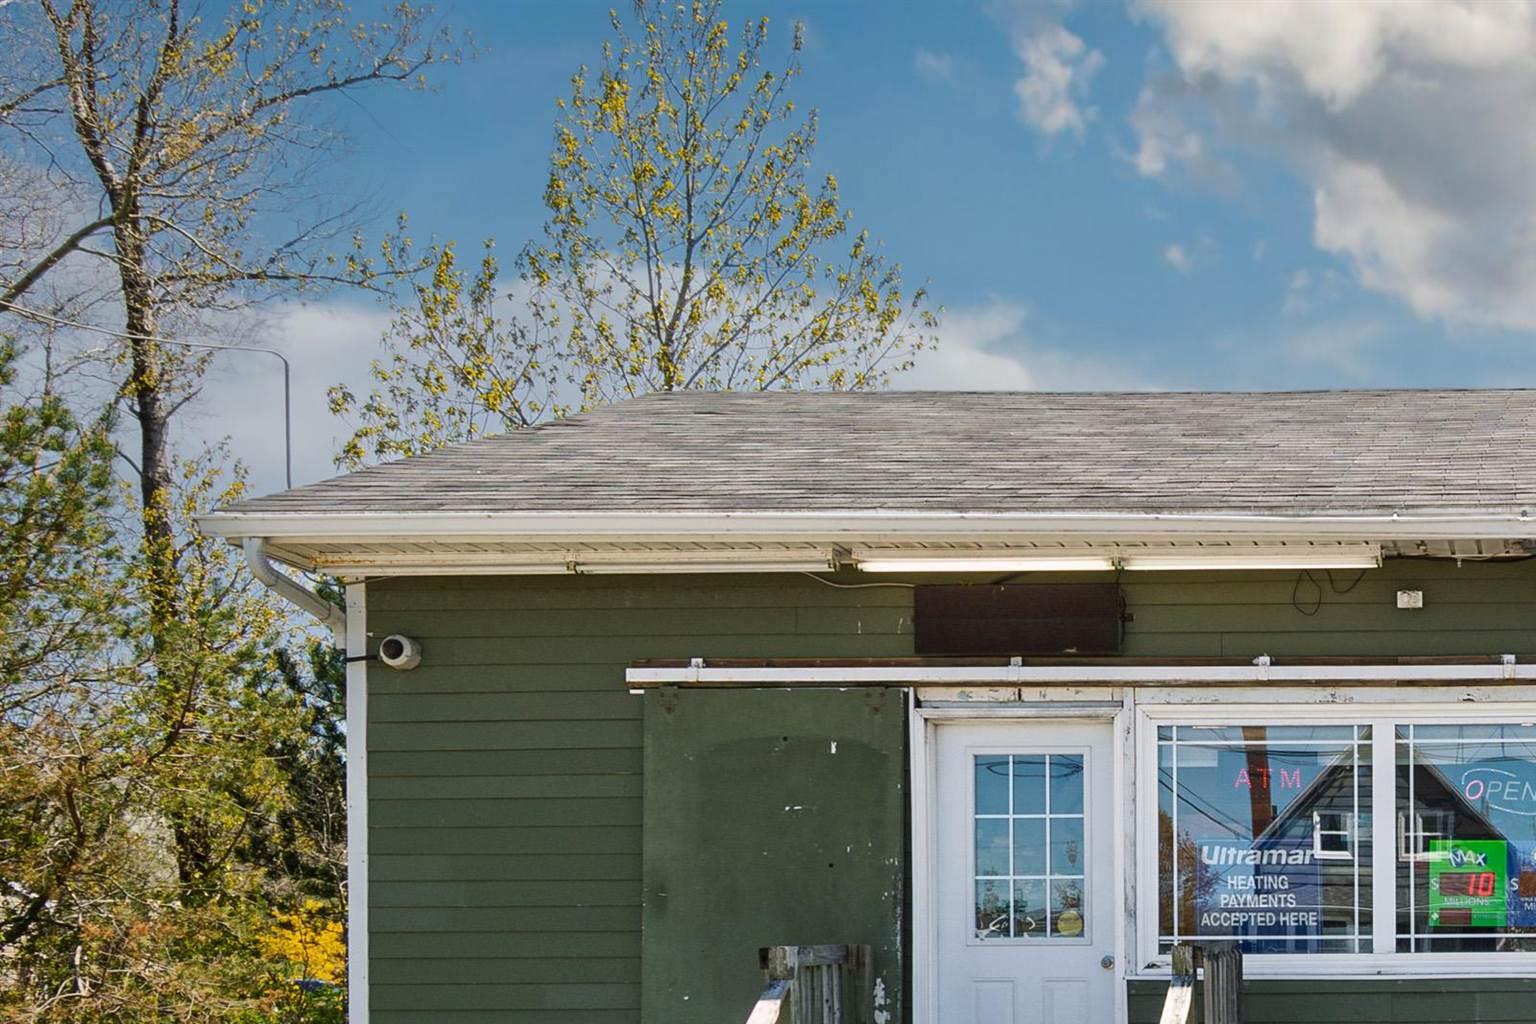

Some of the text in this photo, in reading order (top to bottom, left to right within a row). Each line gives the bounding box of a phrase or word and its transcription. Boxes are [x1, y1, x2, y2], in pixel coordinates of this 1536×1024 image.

[1234, 767, 1303, 789] ATM
[1201, 845, 1316, 865] Ultramar
[1449, 848, 1486, 867] MAX
[1227, 875, 1289, 890] HEATING
[1468, 872, 1495, 896] 10
[1220, 894, 1297, 908] PAYMENTS
[1201, 912, 1318, 926] ACCEPTED HERE
